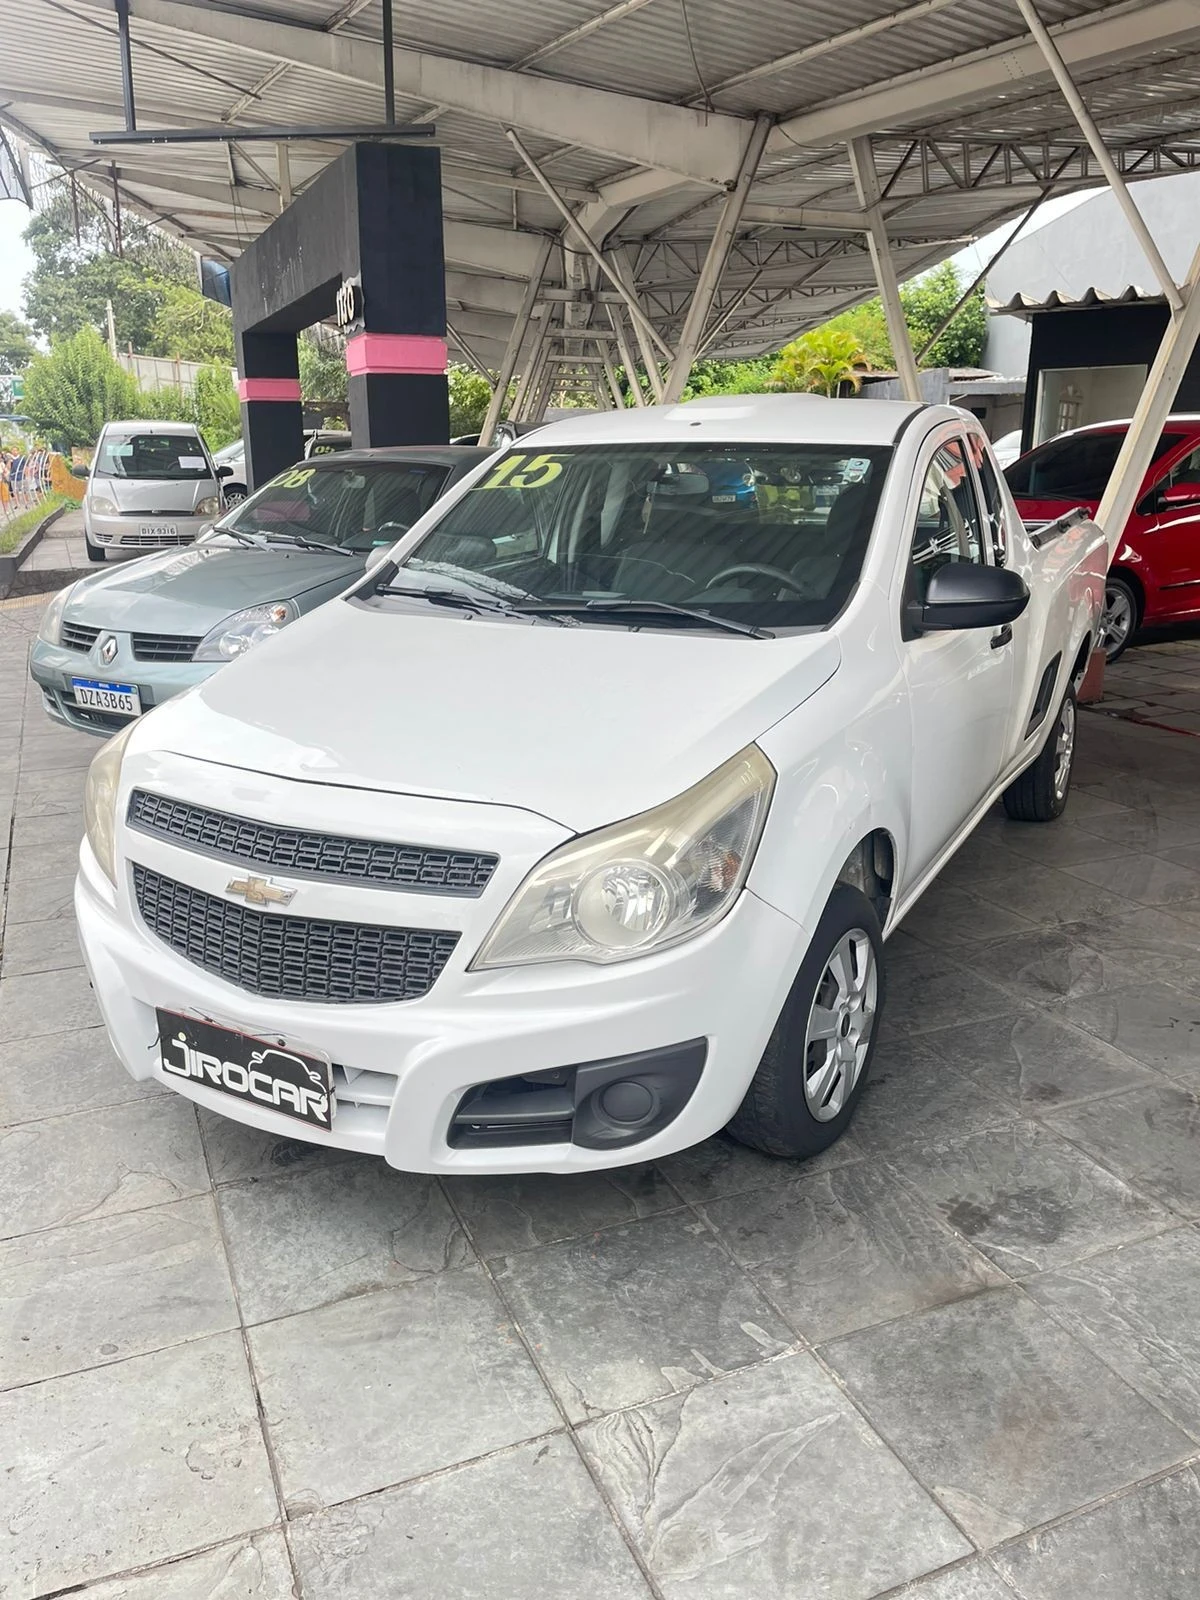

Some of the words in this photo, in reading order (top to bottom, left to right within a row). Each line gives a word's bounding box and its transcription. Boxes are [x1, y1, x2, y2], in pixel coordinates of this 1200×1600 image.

[268, 468, 316, 488] 08
[470, 453, 576, 490] 15
[79, 688, 133, 711] DZA3B65
